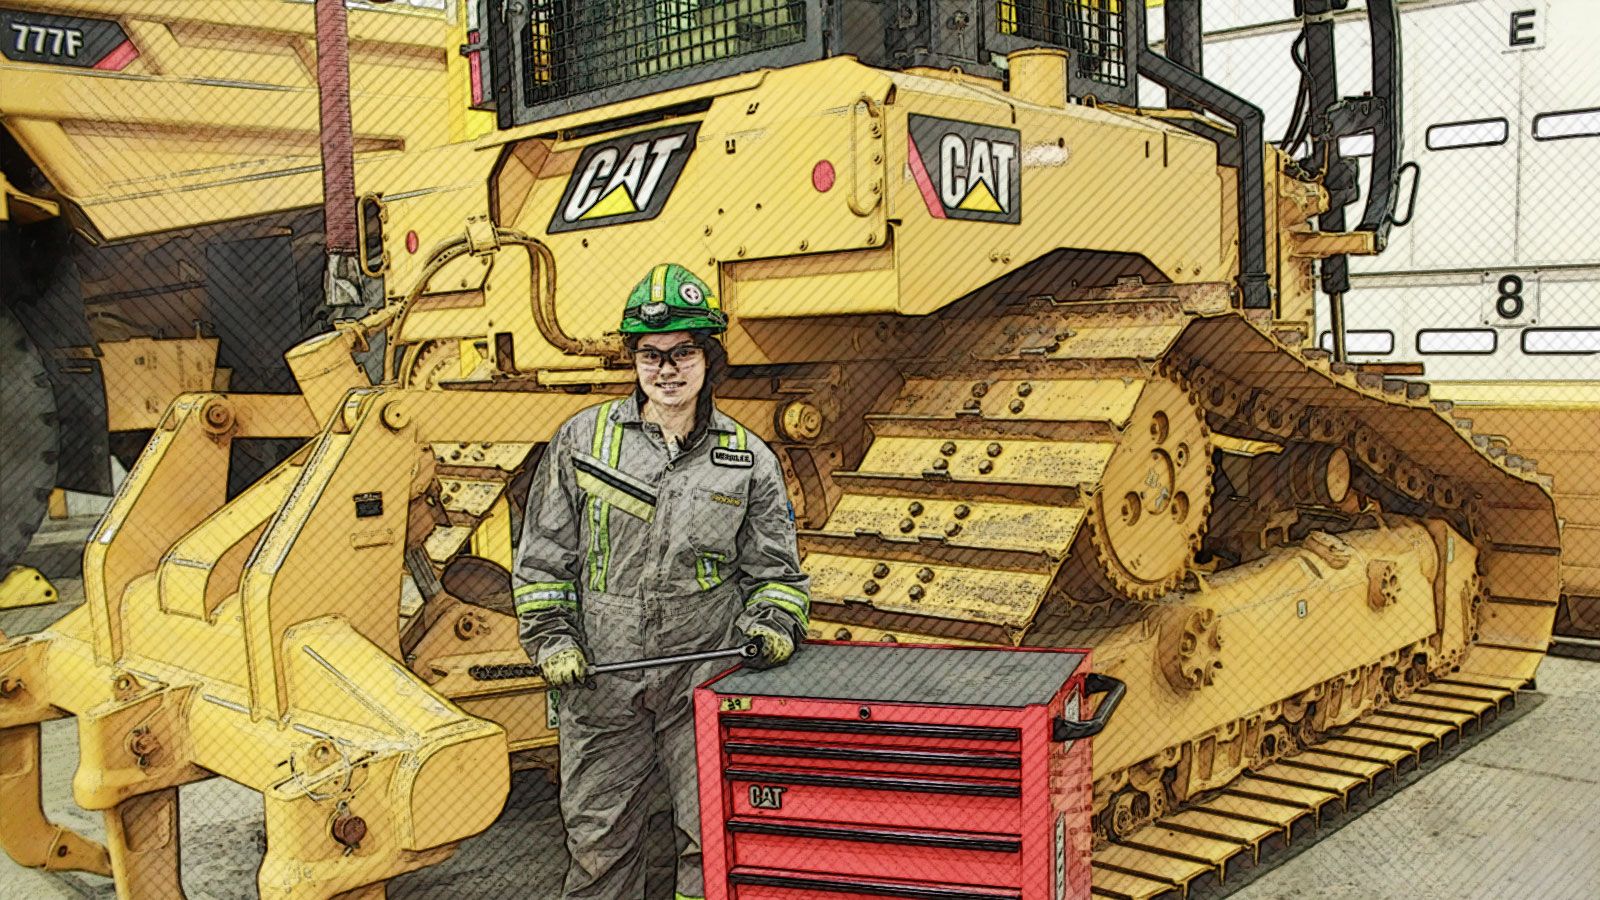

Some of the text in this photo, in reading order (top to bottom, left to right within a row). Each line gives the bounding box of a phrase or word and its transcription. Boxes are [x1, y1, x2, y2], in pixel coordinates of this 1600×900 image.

[11, 22, 83, 58] 777F
[1509, 9, 1536, 46] E
[563, 133, 688, 223] CAT
[939, 132, 1016, 214] CAT
[1496, 274, 1524, 320] 8
[749, 785, 786, 809] CAT
